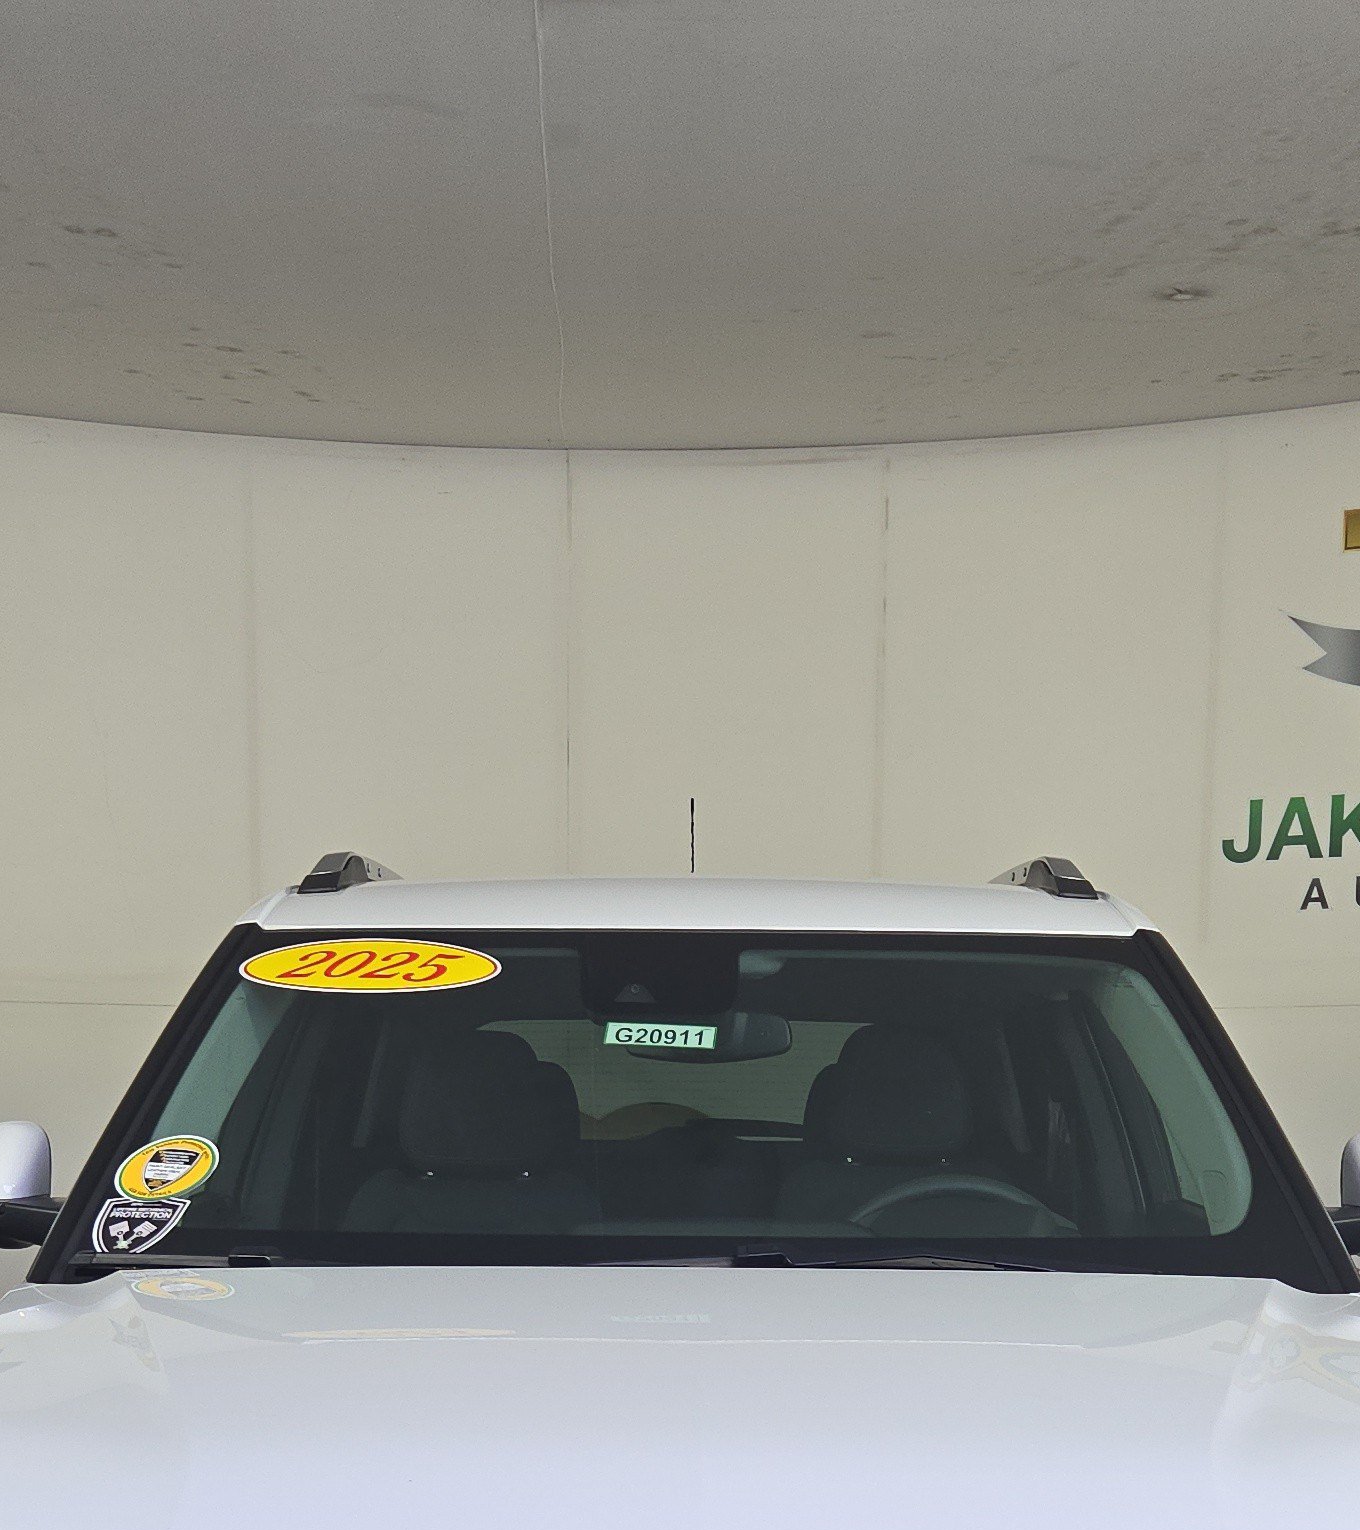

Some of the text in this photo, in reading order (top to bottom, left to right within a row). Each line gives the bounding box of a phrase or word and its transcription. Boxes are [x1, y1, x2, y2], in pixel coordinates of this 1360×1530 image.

[276, 951, 465, 982] 2025
[615, 1027, 704, 1046] G20911
[110, 1211, 173, 1219] PROTECTION
